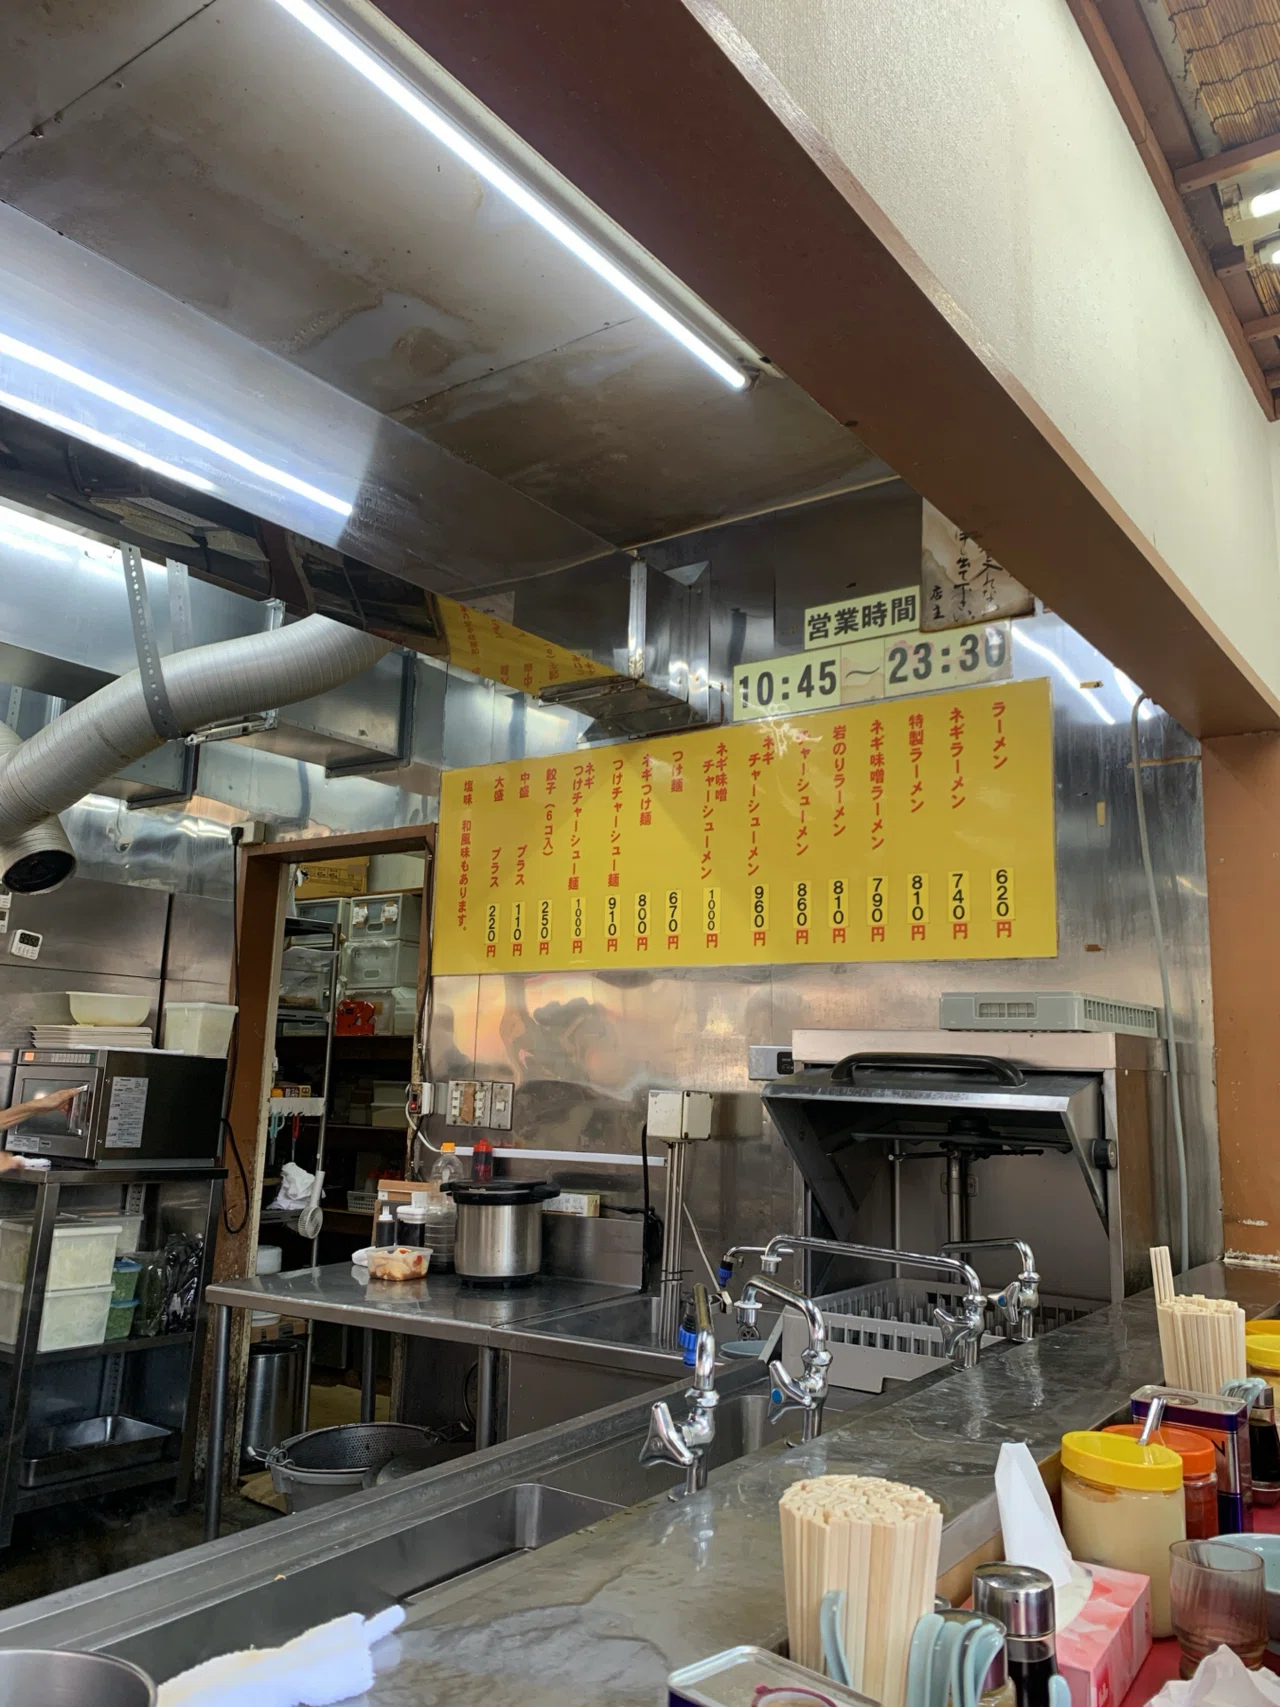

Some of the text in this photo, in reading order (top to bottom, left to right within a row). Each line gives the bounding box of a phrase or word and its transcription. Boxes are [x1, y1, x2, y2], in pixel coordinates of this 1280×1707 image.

[807, 594, 917, 642] 営業時間
[930, 585, 945, 620] 店主
[568, 764, 583, 891] つけチャーシュー麺
[584, 761, 595, 789] ネギ
[700, 759, 716, 880] チャーシューメン
[761, 735, 775, 765] ネギ
[832, 724, 848, 944] 岩のりラーメン 810円
[869, 720, 885, 943] ネギ味噌ラーメン 790円
[908, 714, 926, 941] 特製ラーメン 810円
[949, 707, 968, 940] ネギラーメン 740円
[991, 702, 1012, 938] ラーメン 620円
[458, 779, 474, 931] 塩味 和風味もあります。
[486, 776, 504, 958] 大盛 プラス 220円
[512, 772, 530, 956] 中盛 プラス 110円
[539, 901, 550, 955] 250円
[607, 759, 624, 952] つけチャーシュー麺 910円
[637, 753, 653, 951] ネギつけ麺 800円
[667, 750, 684, 949] つけ麺 670円
[747, 752, 766, 947] チャーシューメン 960円
[796, 883, 809, 945] 860円
